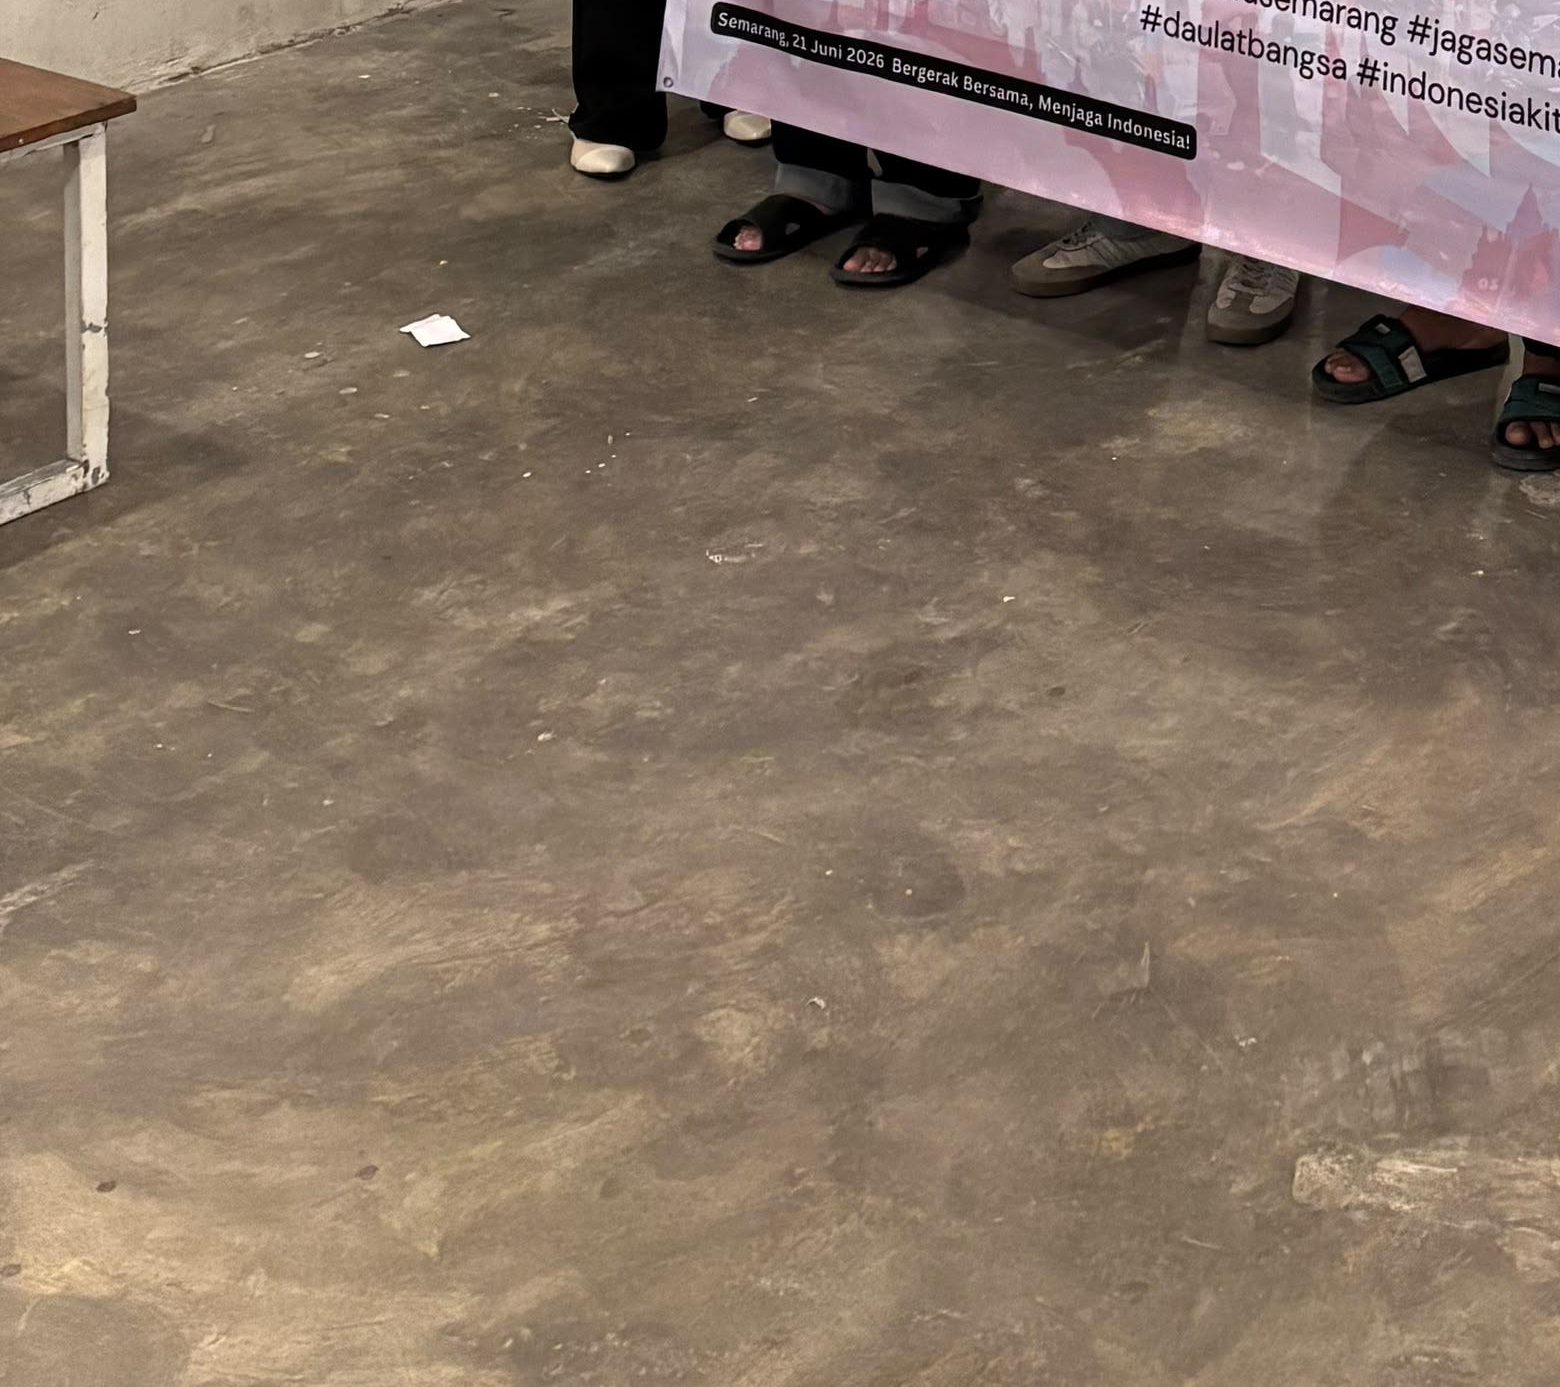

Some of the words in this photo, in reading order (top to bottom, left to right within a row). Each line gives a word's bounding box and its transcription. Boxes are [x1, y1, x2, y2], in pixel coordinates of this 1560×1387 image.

[717, 12, 790, 47] Semarang,
[792, 33, 807, 51] 21
[810, 40, 843, 60] Juni
[846, 47, 885, 69] 2026
[892, 58, 959, 88] Bergerak
[963, 75, 1034, 111] Bersama,
[1038, 95, 1103, 127] Menjaga
[1108, 113, 1191, 150] Indonesia!
[1140, 4, 1348, 80] #daulatbangsa
